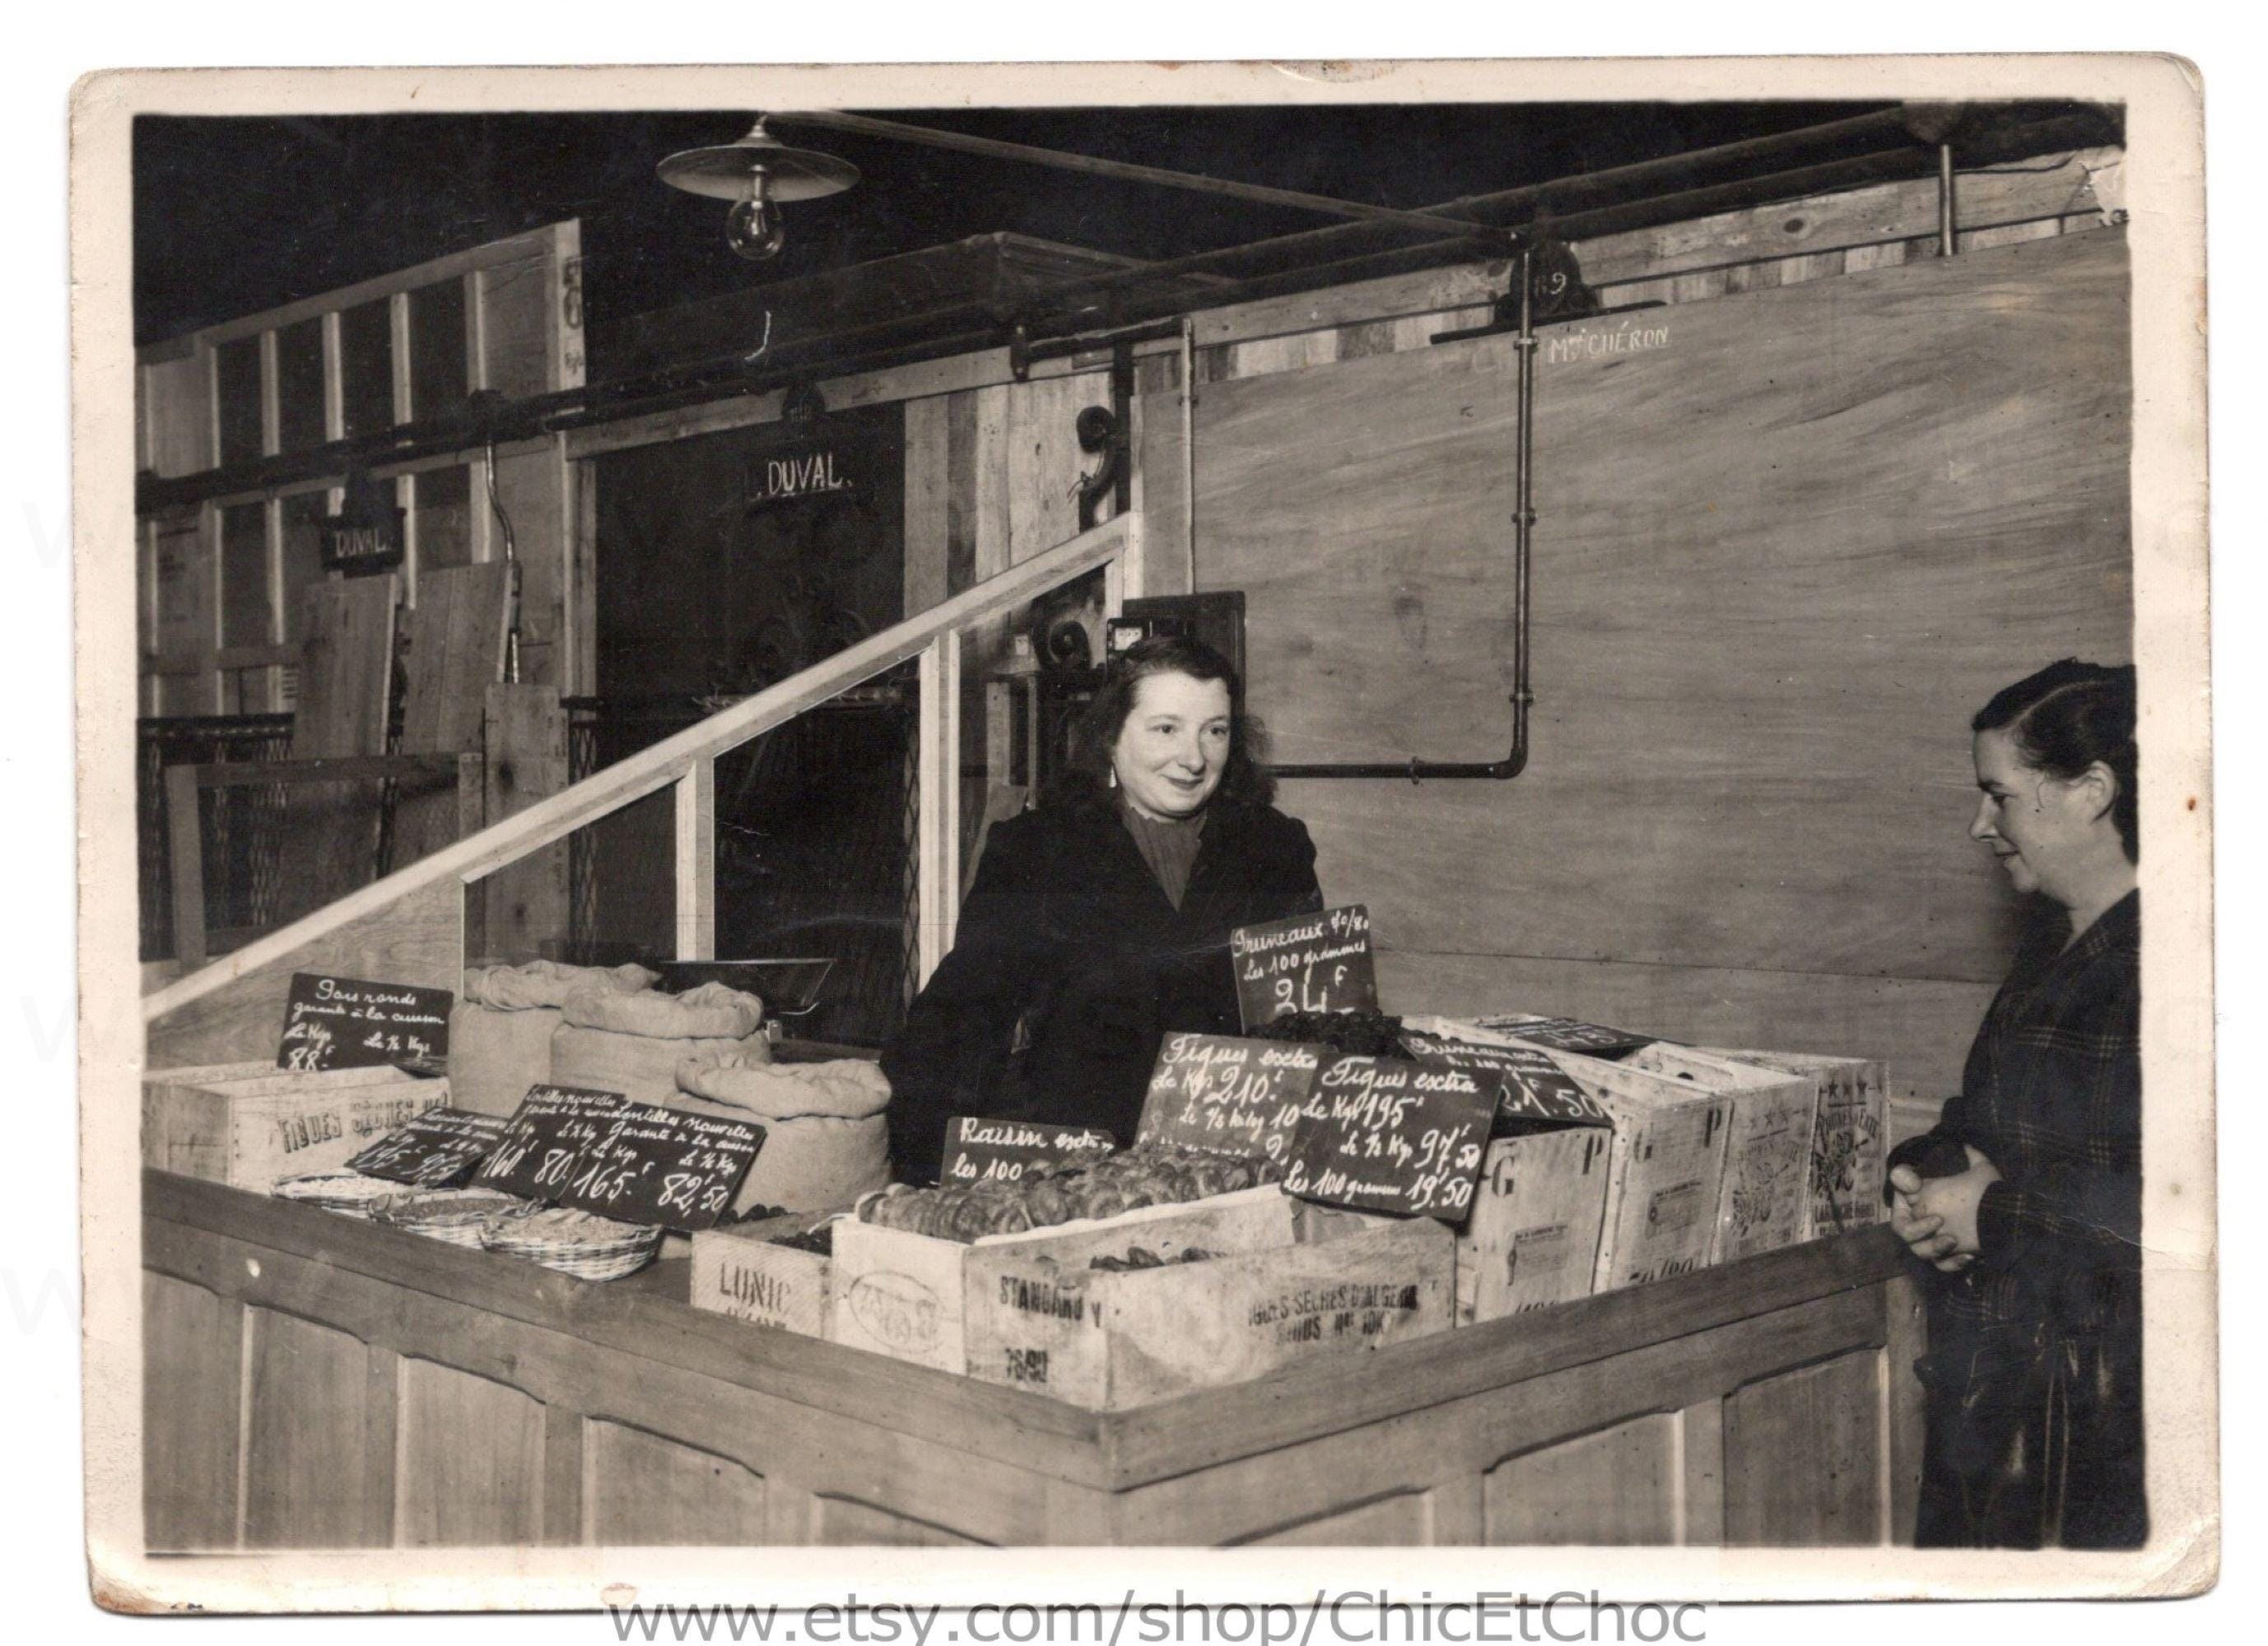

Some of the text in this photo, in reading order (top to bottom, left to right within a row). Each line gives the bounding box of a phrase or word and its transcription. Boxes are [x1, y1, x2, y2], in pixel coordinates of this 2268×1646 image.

[1269, 954, 1300, 975] 100
[982, 1157, 1023, 1181] 100
[1311, 1168, 1346, 1196] 100
